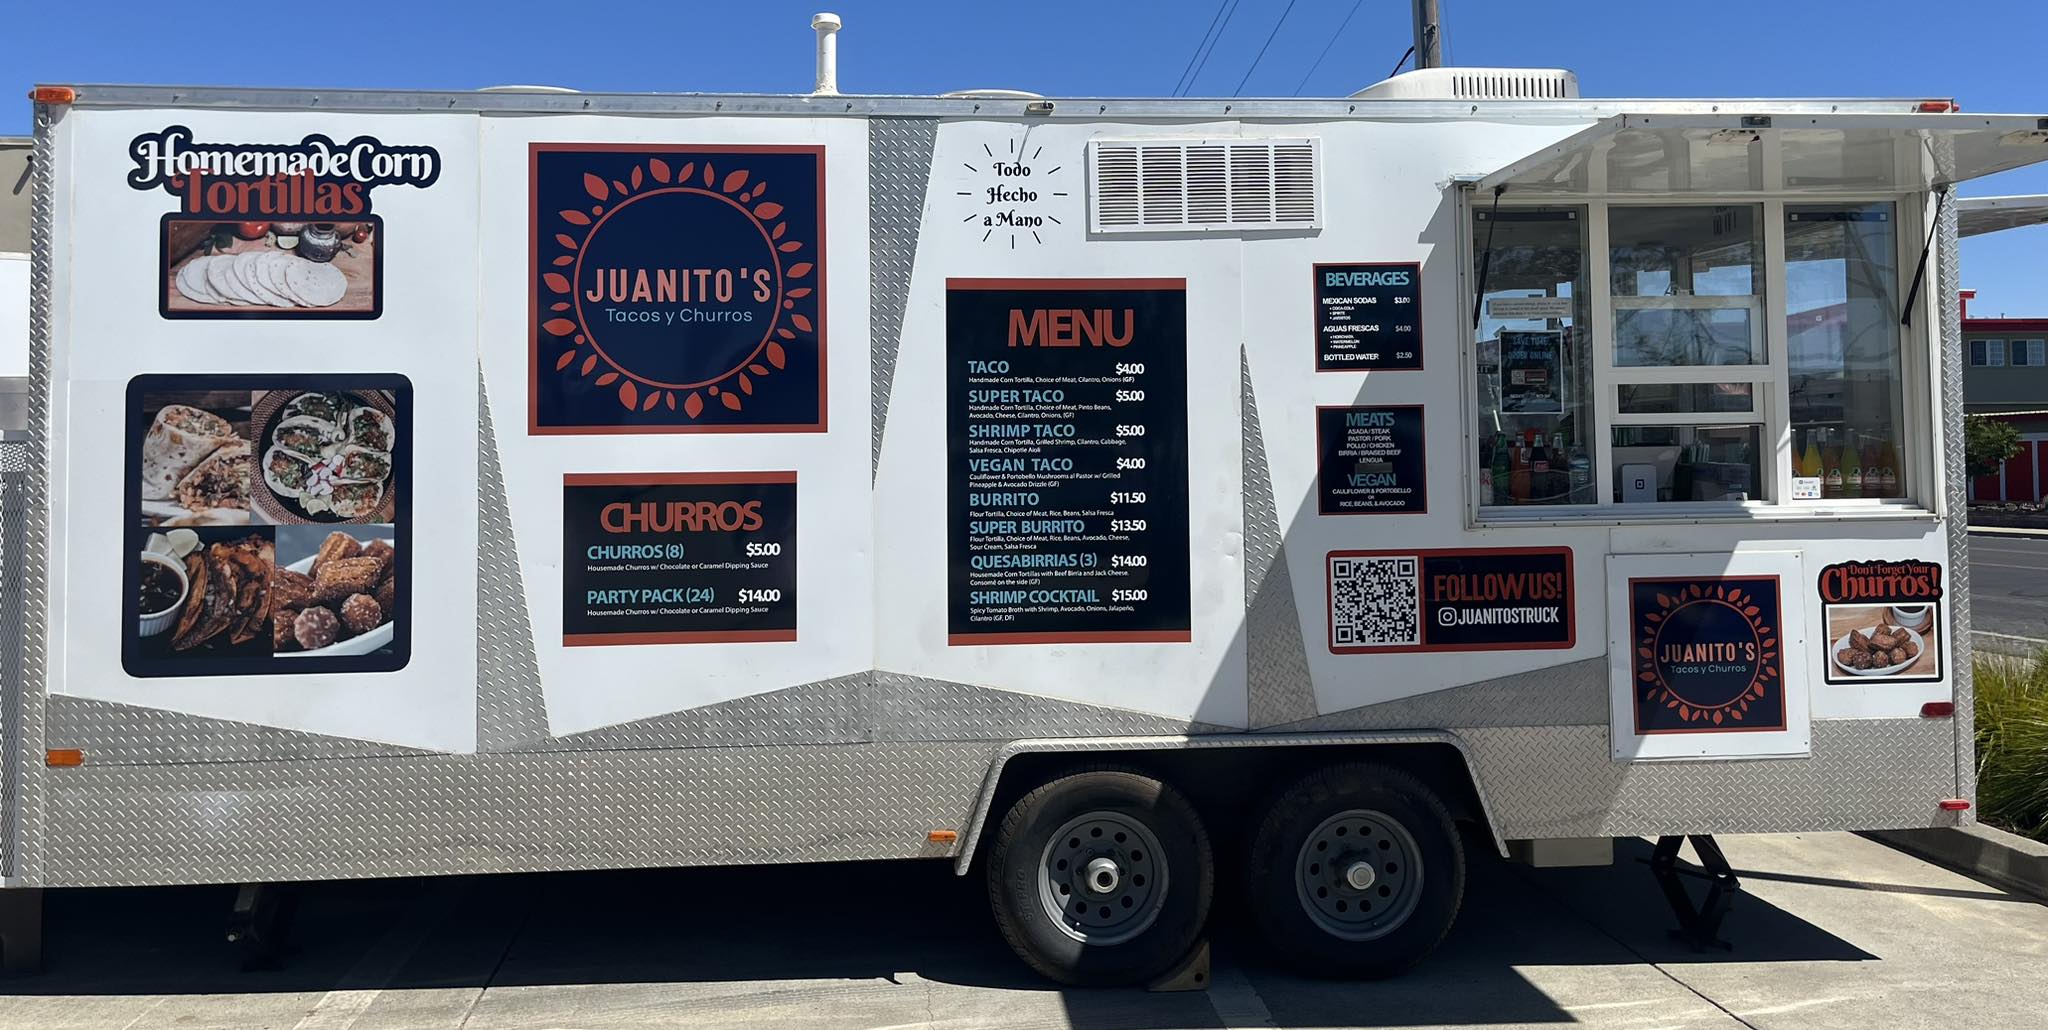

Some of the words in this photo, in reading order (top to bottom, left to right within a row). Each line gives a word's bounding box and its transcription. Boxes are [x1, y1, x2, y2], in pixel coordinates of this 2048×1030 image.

[993, 163, 1030, 176] Todo
[172, 168, 363, 214] Tortillas
[987, 184, 1037, 204] Hecho
[984, 216, 992, 226] a
[996, 210, 1042, 227] Mano
[587, 268, 771, 303] JUANITO'S
[1326, 272, 1409, 286] BEVERAGES
[606, 308, 660, 322] Tacos
[666, 312, 675, 329] y
[680, 308, 753, 322] Churros
[1008, 310, 1133, 347] MENU
[968, 361, 1009, 373] TACO
[1116, 363, 1144, 375] $4.00
[969, 390, 1019, 402] SUPER
[1023, 390, 1064, 402] TACO
[1116, 390, 1144, 402] $5.00
[1346, 413, 1395, 426] MEATS
[969, 425, 1030, 437] SHRIMP
[1034, 425, 1075, 437] TACO
[1116, 425, 1144, 436] $5.00
[969, 459, 1024, 471] VEGAN
[1032, 458, 1073, 471] TACO
[1117, 458, 1145, 469] $4.00
[1348, 474, 1396, 486] VEGAN
[970, 493, 1039, 506] BURRITO
[1111, 491, 1146, 504] $11.50
[600, 501, 764, 533] CHURROS
[970, 521, 1016, 534] SUPER
[1022, 520, 1084, 533] BURRITO
[1111, 519, 1146, 531] $13.50
[588, 545, 663, 560] CHURROS
[665, 544, 684, 559] (8)
[746, 543, 780, 557] $5.00
[971, 554, 1077, 569] QUESABIRRIAS
[1080, 553, 1097, 568] (3)
[1112, 555, 1146, 567] $14.00
[1847, 565, 1874, 575] Don't
[1874, 564, 1905, 576] Forget
[1906, 564, 1928, 574] Your
[1434, 573, 1526, 602] FOLLOW
[1529, 572, 1562, 599] US!
[1821, 566, 1942, 602] Churros!
[588, 590, 639, 604] PARTY
[642, 589, 683, 603] PACK
[686, 588, 714, 603] (24)
[739, 589, 780, 604] $14.00
[970, 591, 1026, 604] SHRIMP
[1029, 590, 1099, 603] COCKTAIL
[1112, 589, 1147, 602] $15.00
[1458, 607, 1559, 624] JUANITOSTRUCK
[1660, 642, 1755, 663] JUANITO'S
[1670, 665, 1699, 674] Tacos
[1701, 666, 1706, 675] y
[1708, 663, 1747, 673] Churros
